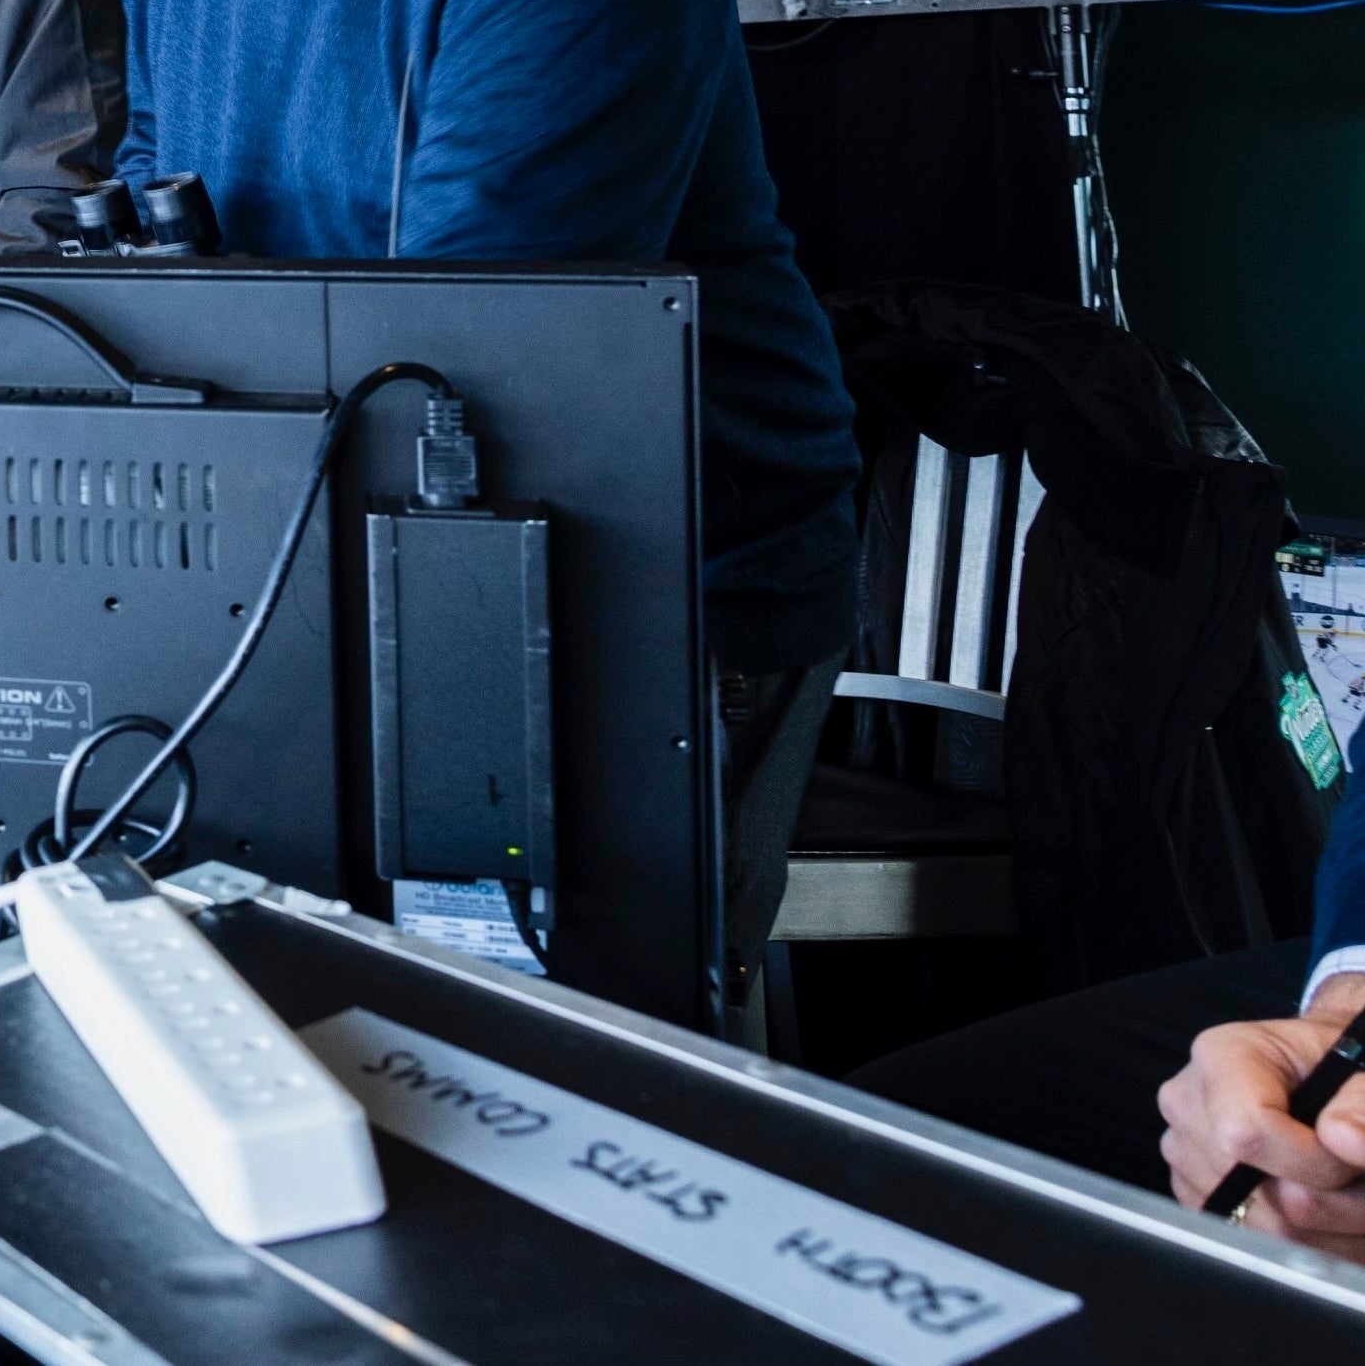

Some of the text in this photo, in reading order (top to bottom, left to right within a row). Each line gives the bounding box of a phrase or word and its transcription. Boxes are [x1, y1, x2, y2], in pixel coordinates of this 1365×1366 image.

[361, 1049, 1001, 1334] BOOTH STATS COMMS
